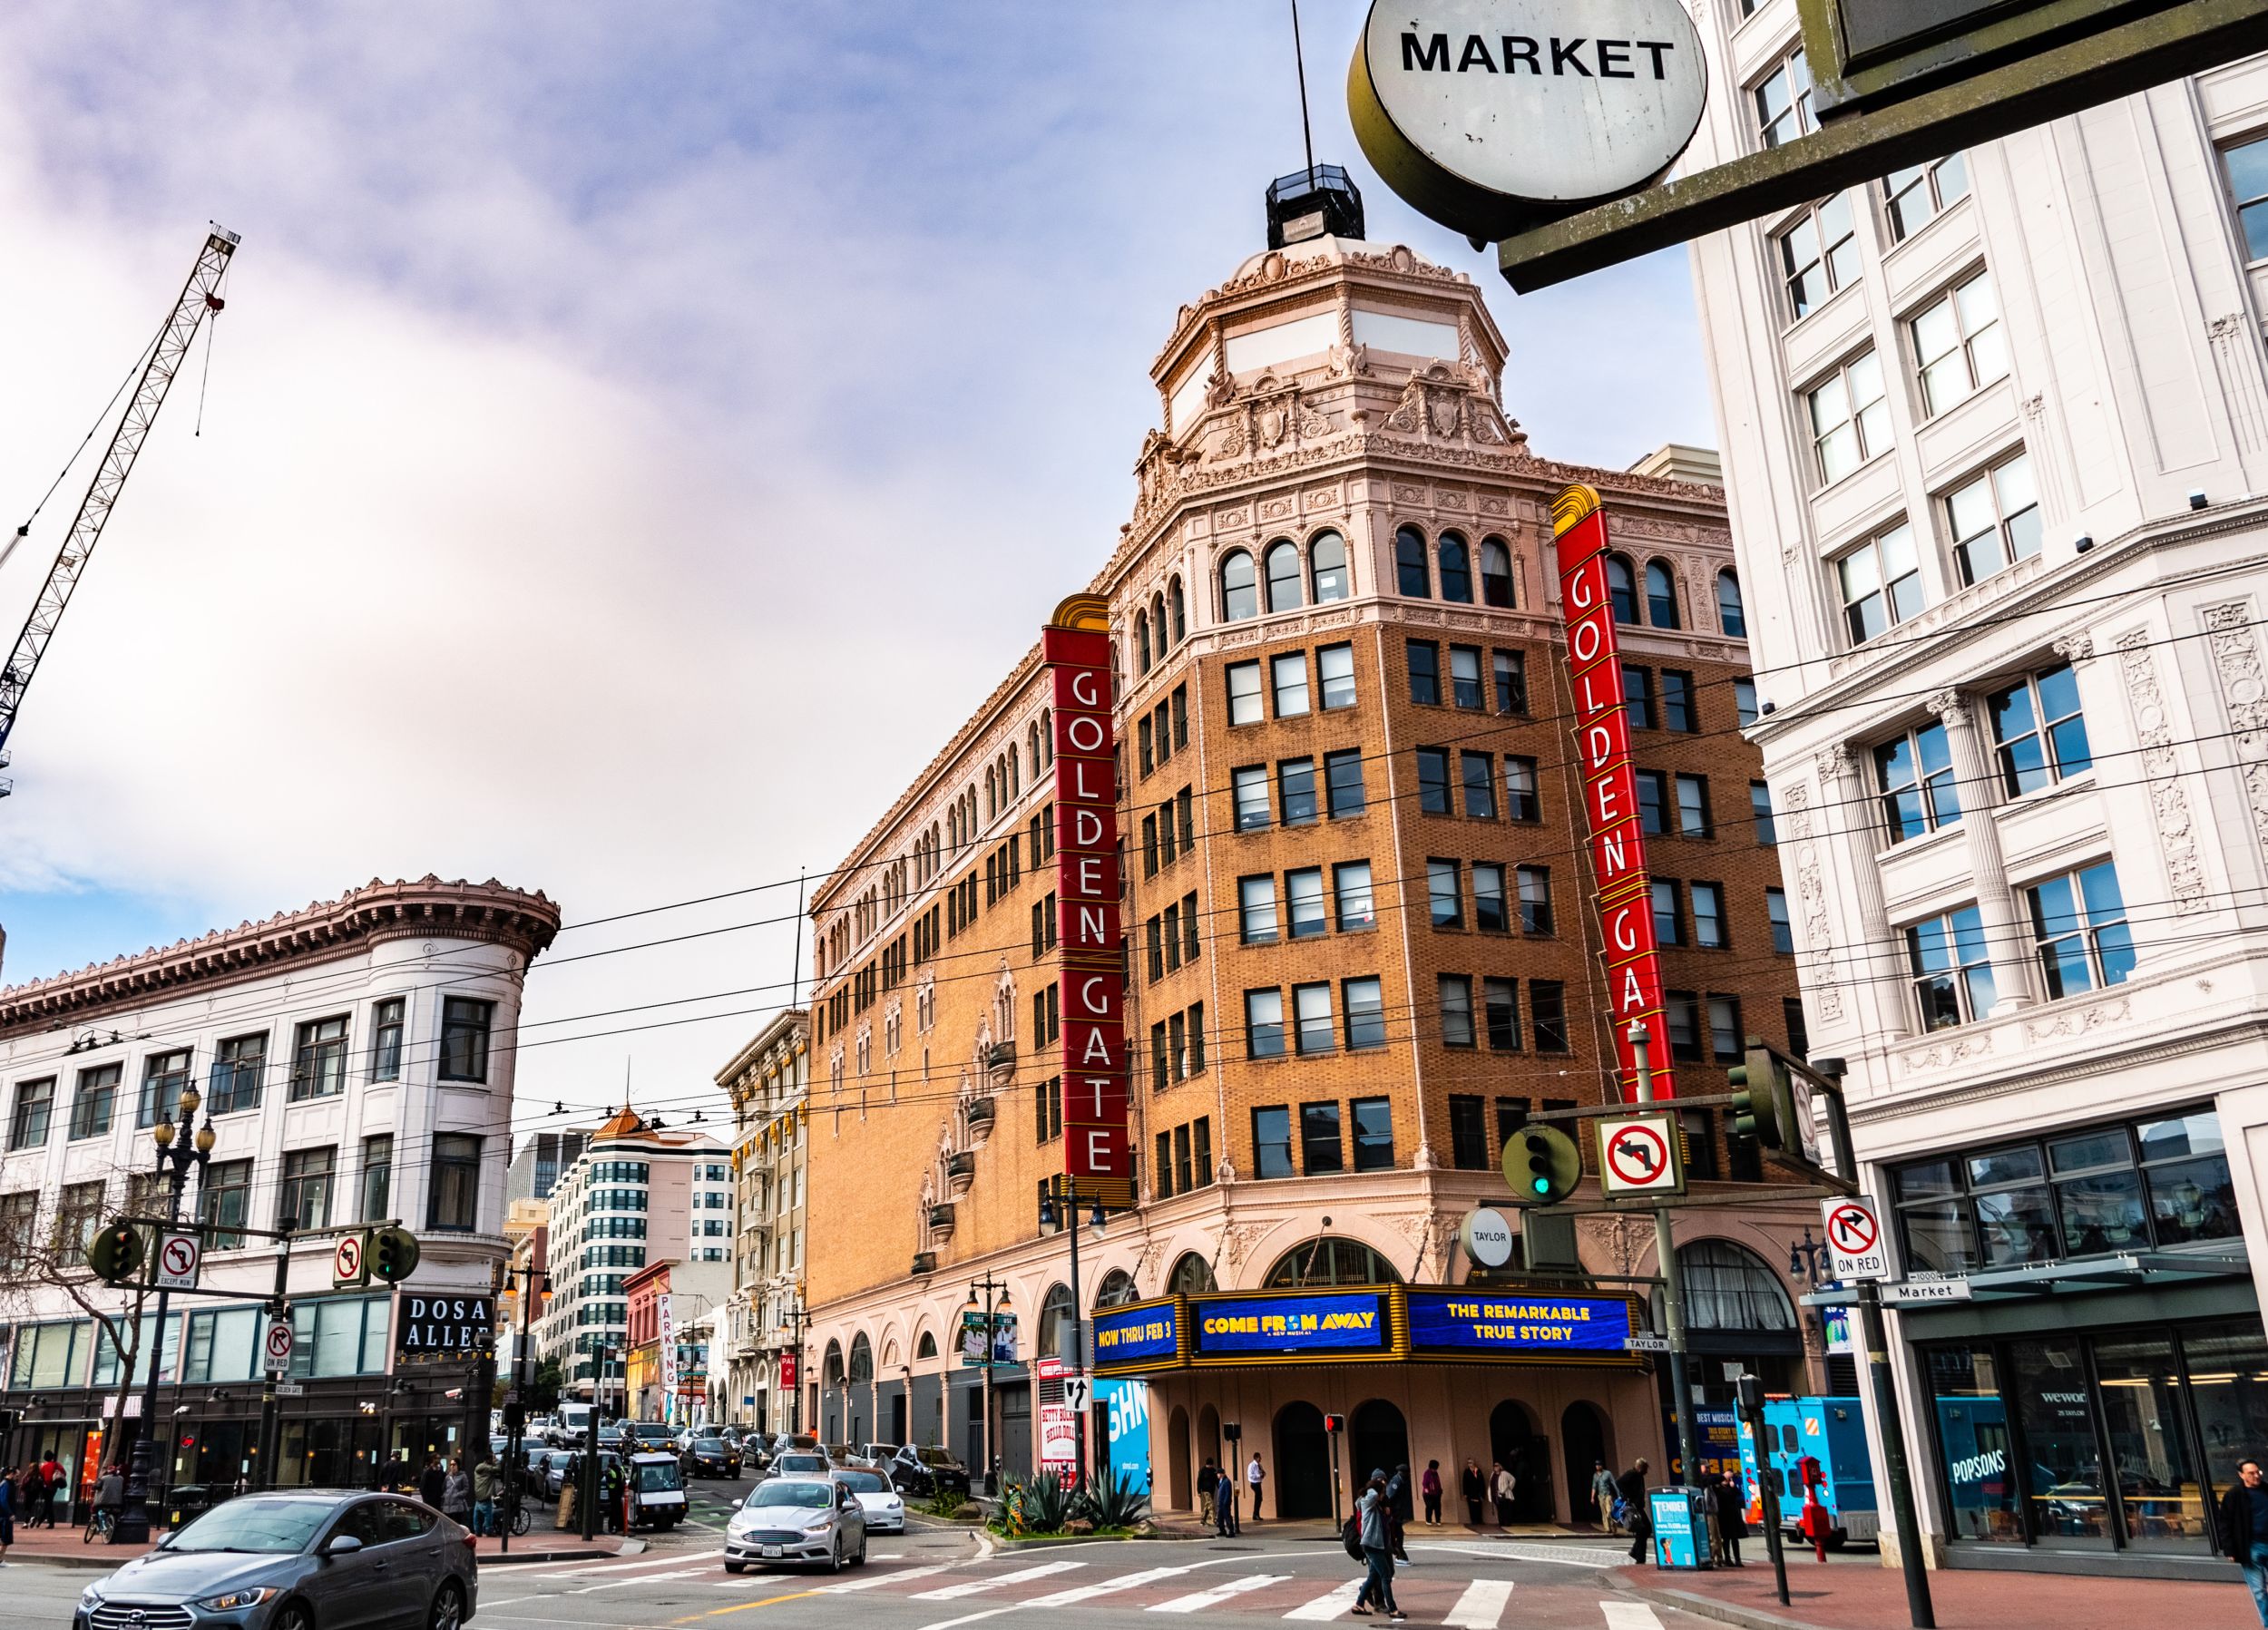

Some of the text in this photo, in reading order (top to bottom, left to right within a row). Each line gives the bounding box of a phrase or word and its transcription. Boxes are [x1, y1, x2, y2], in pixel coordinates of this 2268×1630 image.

[1400, 32, 1675, 81] MARKET
[1570, 567, 1628, 877] GOLDEN
[1068, 670, 1106, 945] GOLDEN
[1081, 975, 1112, 1172] GATE
[1473, 1231, 1507, 1242] TAYLOR
[1838, 1256, 1880, 1273] ON RED
[161, 1277, 192, 1286] EXCEPT MUNI
[1916, 1272, 1938, 1281] 1000
[1898, 1284, 1953, 1299] Market
[409, 1299, 486, 1320] DOSA
[1447, 1303, 1590, 1322] THE REMARKABLE
[1203, 1312, 1375, 1334] COME FROM AWAY
[660, 1296, 675, 1382] PARKING
[1099, 1322, 1171, 1348] NOW THRU FEB 3
[1473, 1324, 1573, 1341] TRUE STORY
[1629, 1340, 1665, 1349] TAYLOR
[267, 1358, 288, 1368] ON RED
[2040, 1391, 2087, 1403] wewor
[1042, 1408, 1059, 1422] BETTY
[1696, 1412, 1735, 1423] BEST MUSICA
[1046, 1424, 1062, 1444] HELLO
[1951, 1449, 2007, 1485] POPSONS
